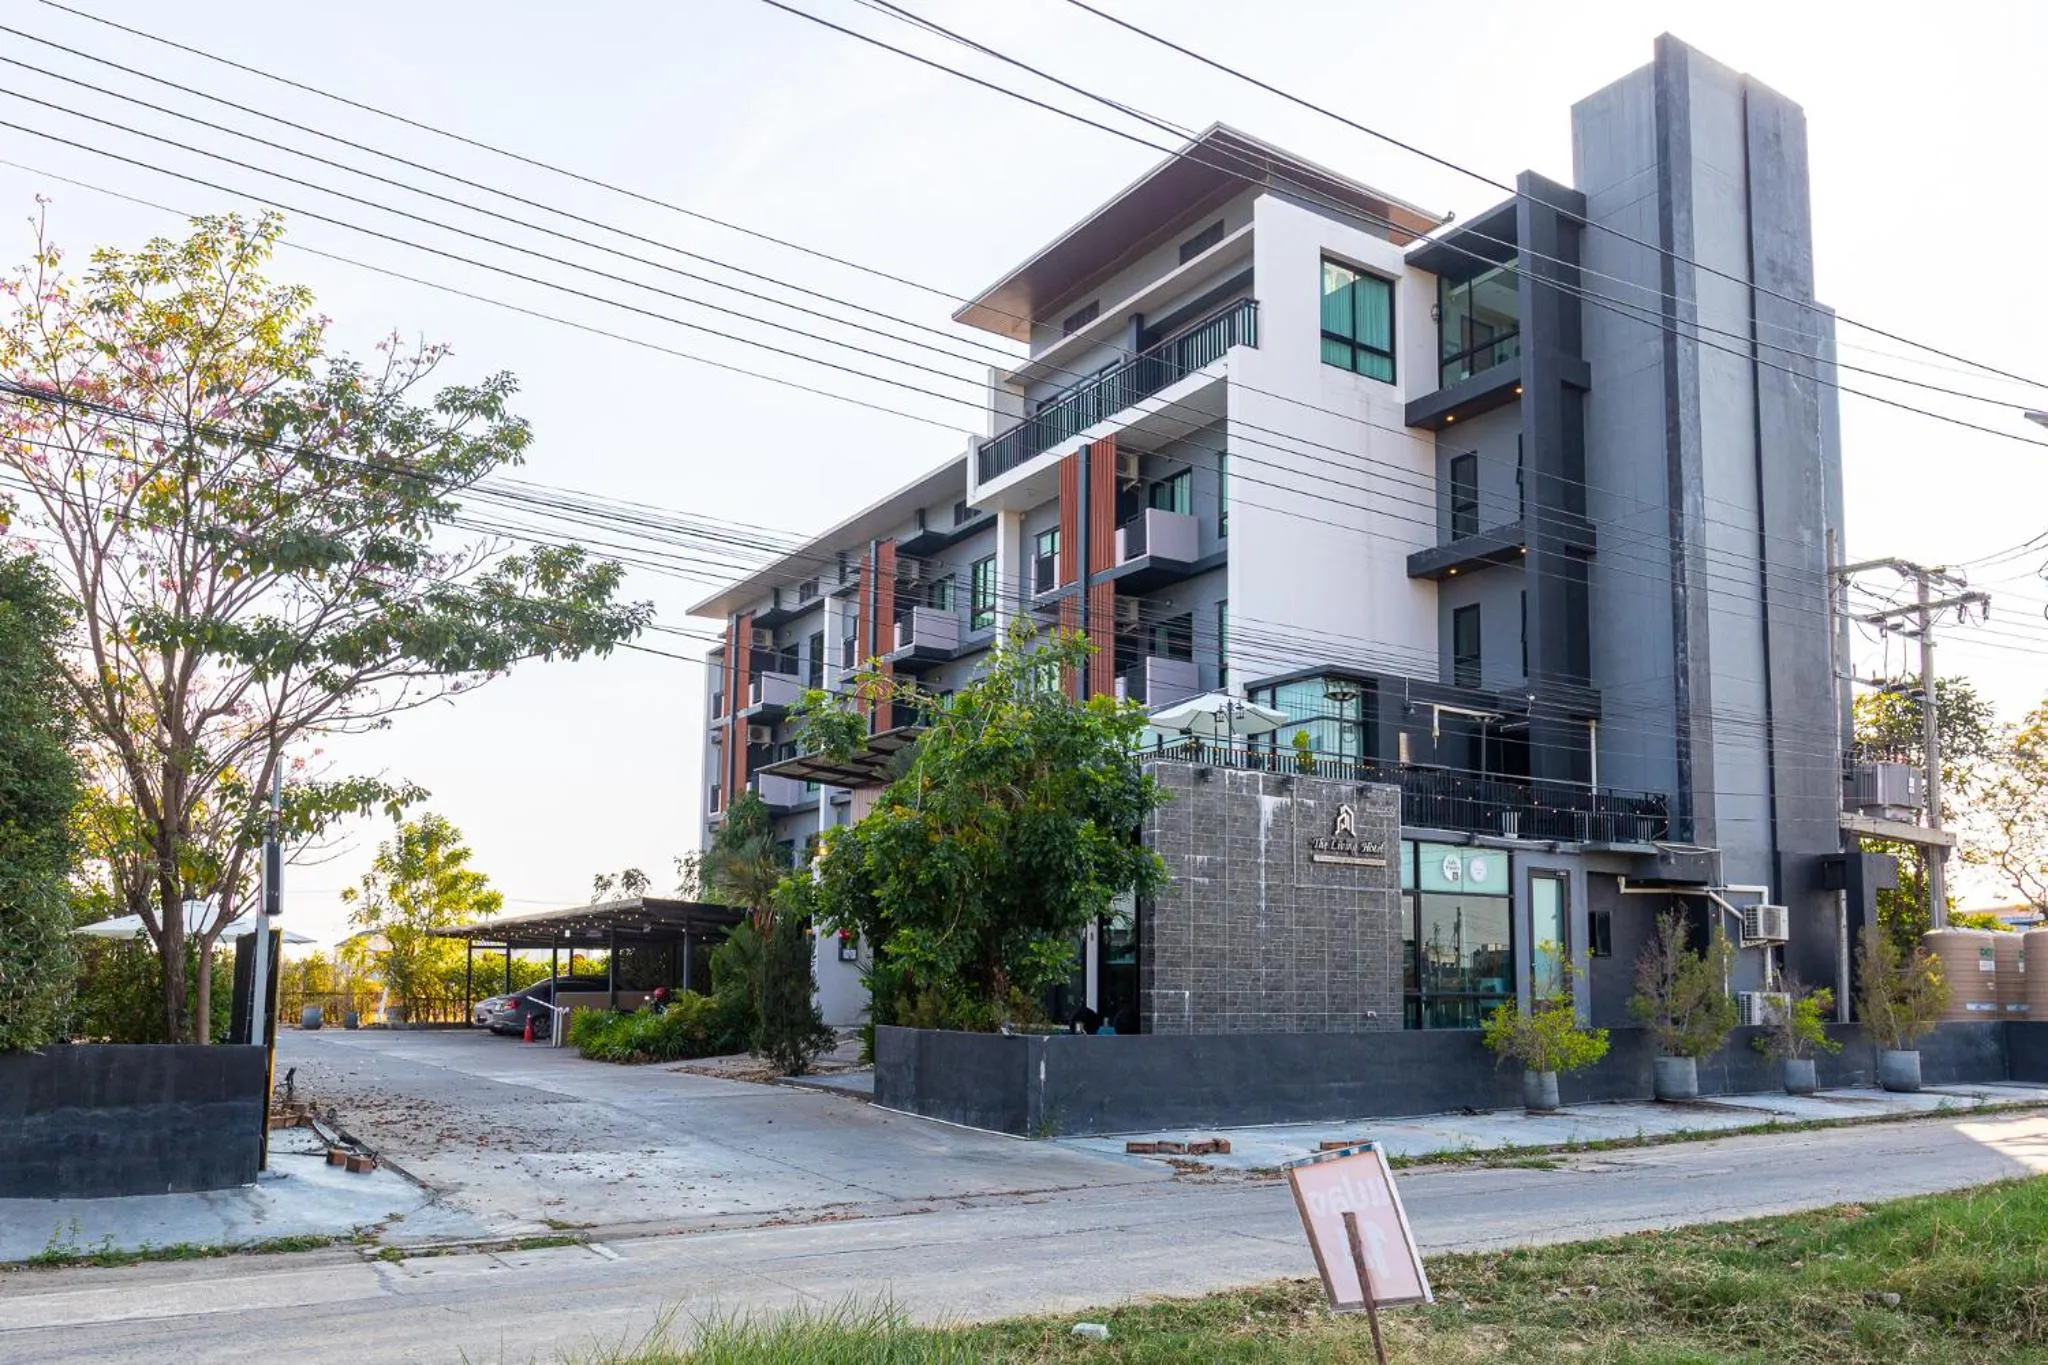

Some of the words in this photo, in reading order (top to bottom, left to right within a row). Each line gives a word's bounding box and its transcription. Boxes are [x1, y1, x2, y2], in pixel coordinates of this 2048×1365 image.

[1313, 837, 1328, 849] The
[1331, 839, 1358, 856] Living
[1361, 841, 1385, 853] Hotel
